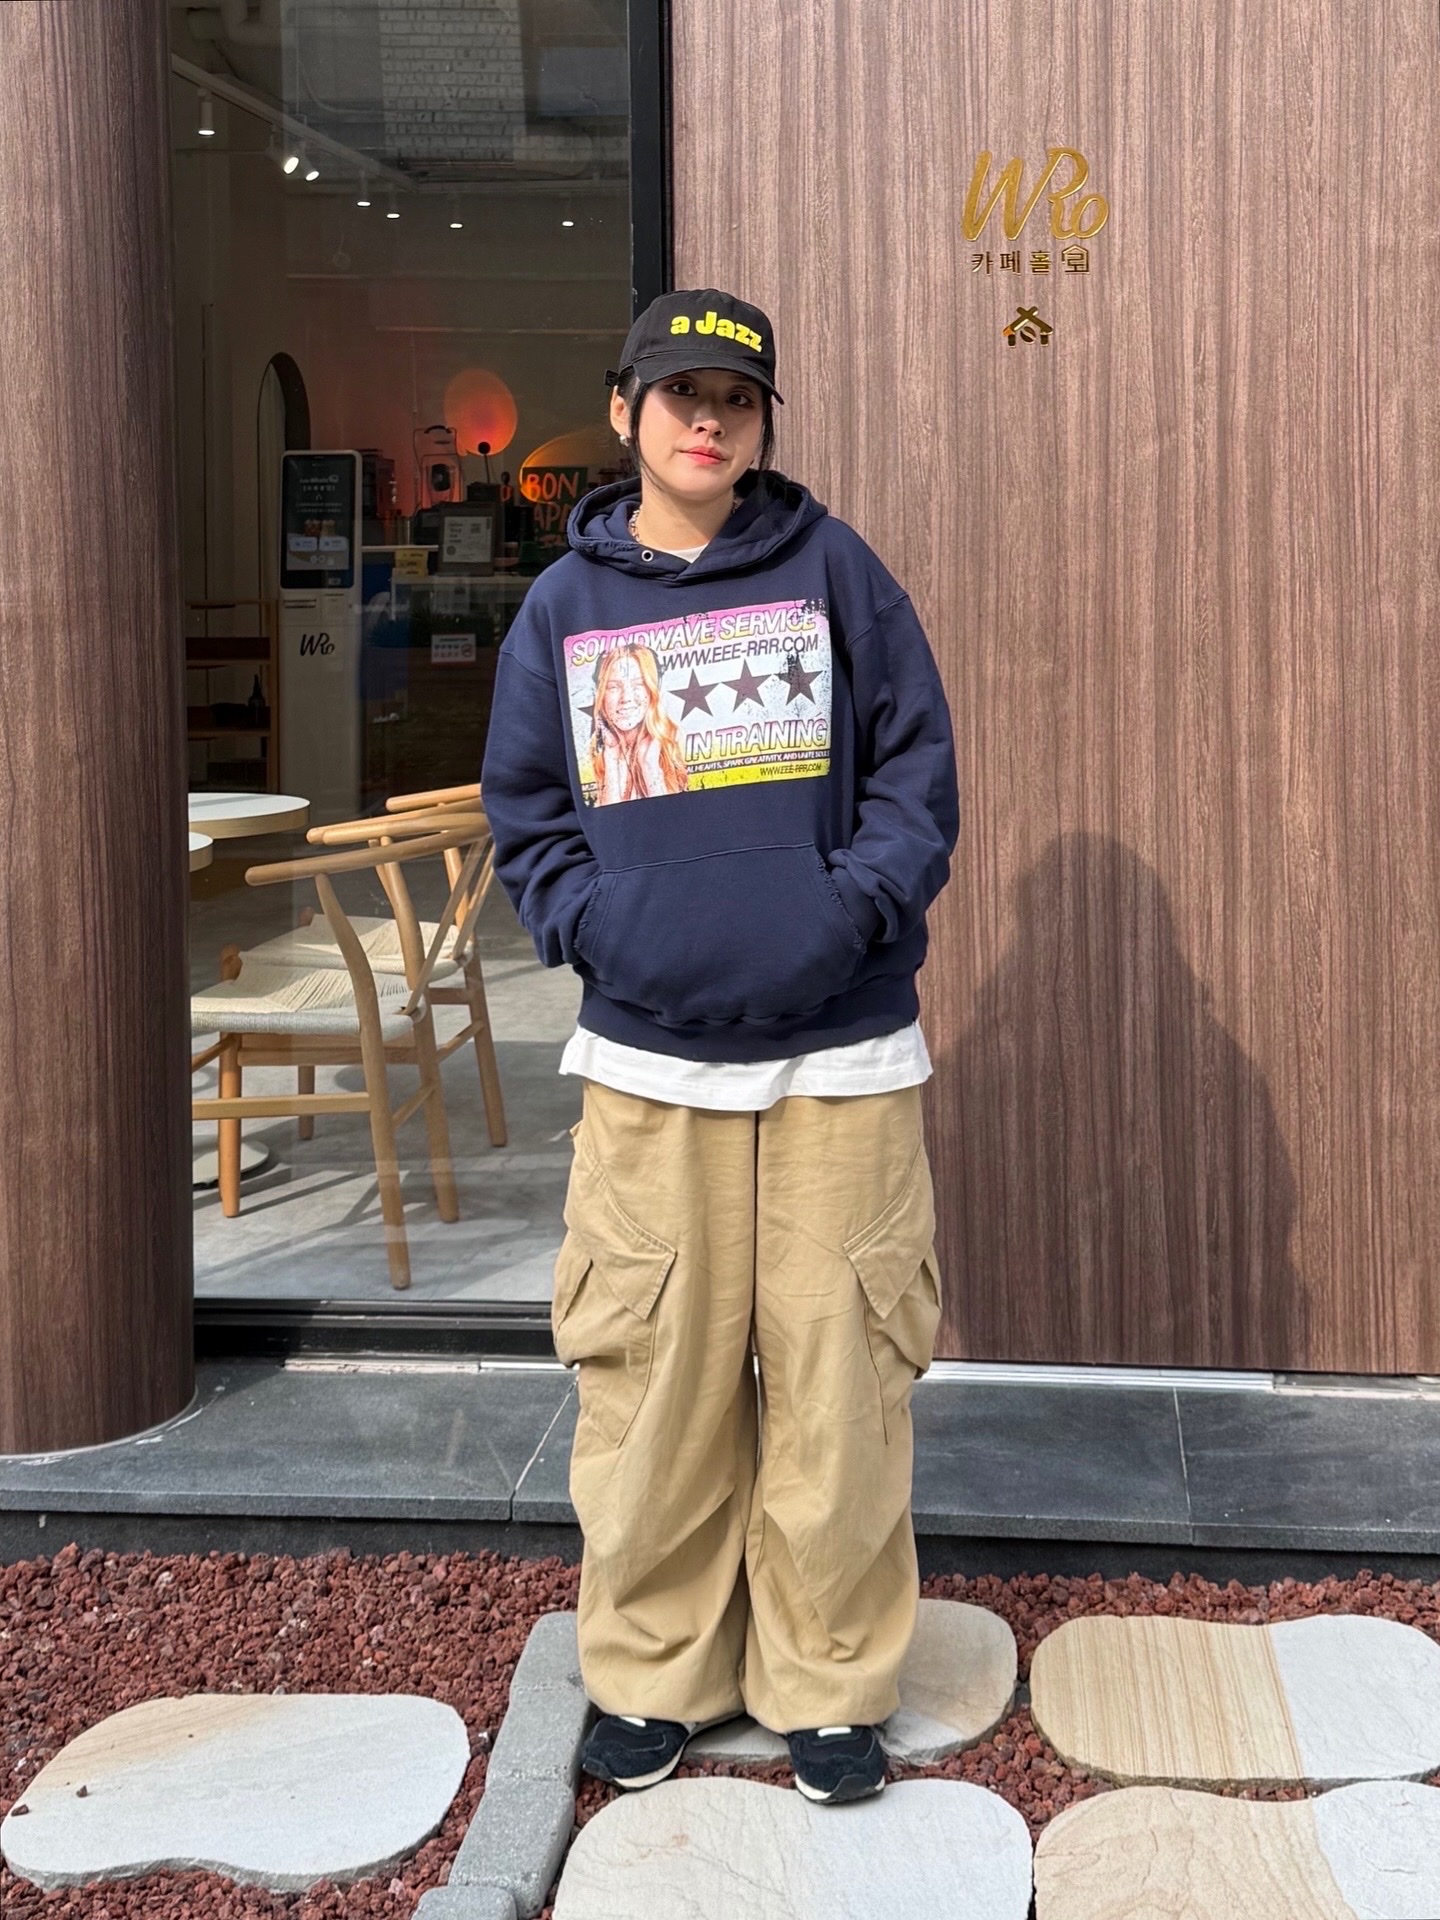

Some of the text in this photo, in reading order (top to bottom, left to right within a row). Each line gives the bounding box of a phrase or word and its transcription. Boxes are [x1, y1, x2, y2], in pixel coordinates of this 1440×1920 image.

[670, 311, 763, 353] a Jazz
[526, 472, 579, 501] BON
[571, 607, 816, 667] SOUNDWAVE SERVICE
[663, 634, 819, 671] WWW.EEE-RRR.COM
[684, 718, 828, 762] IN TRAINING
